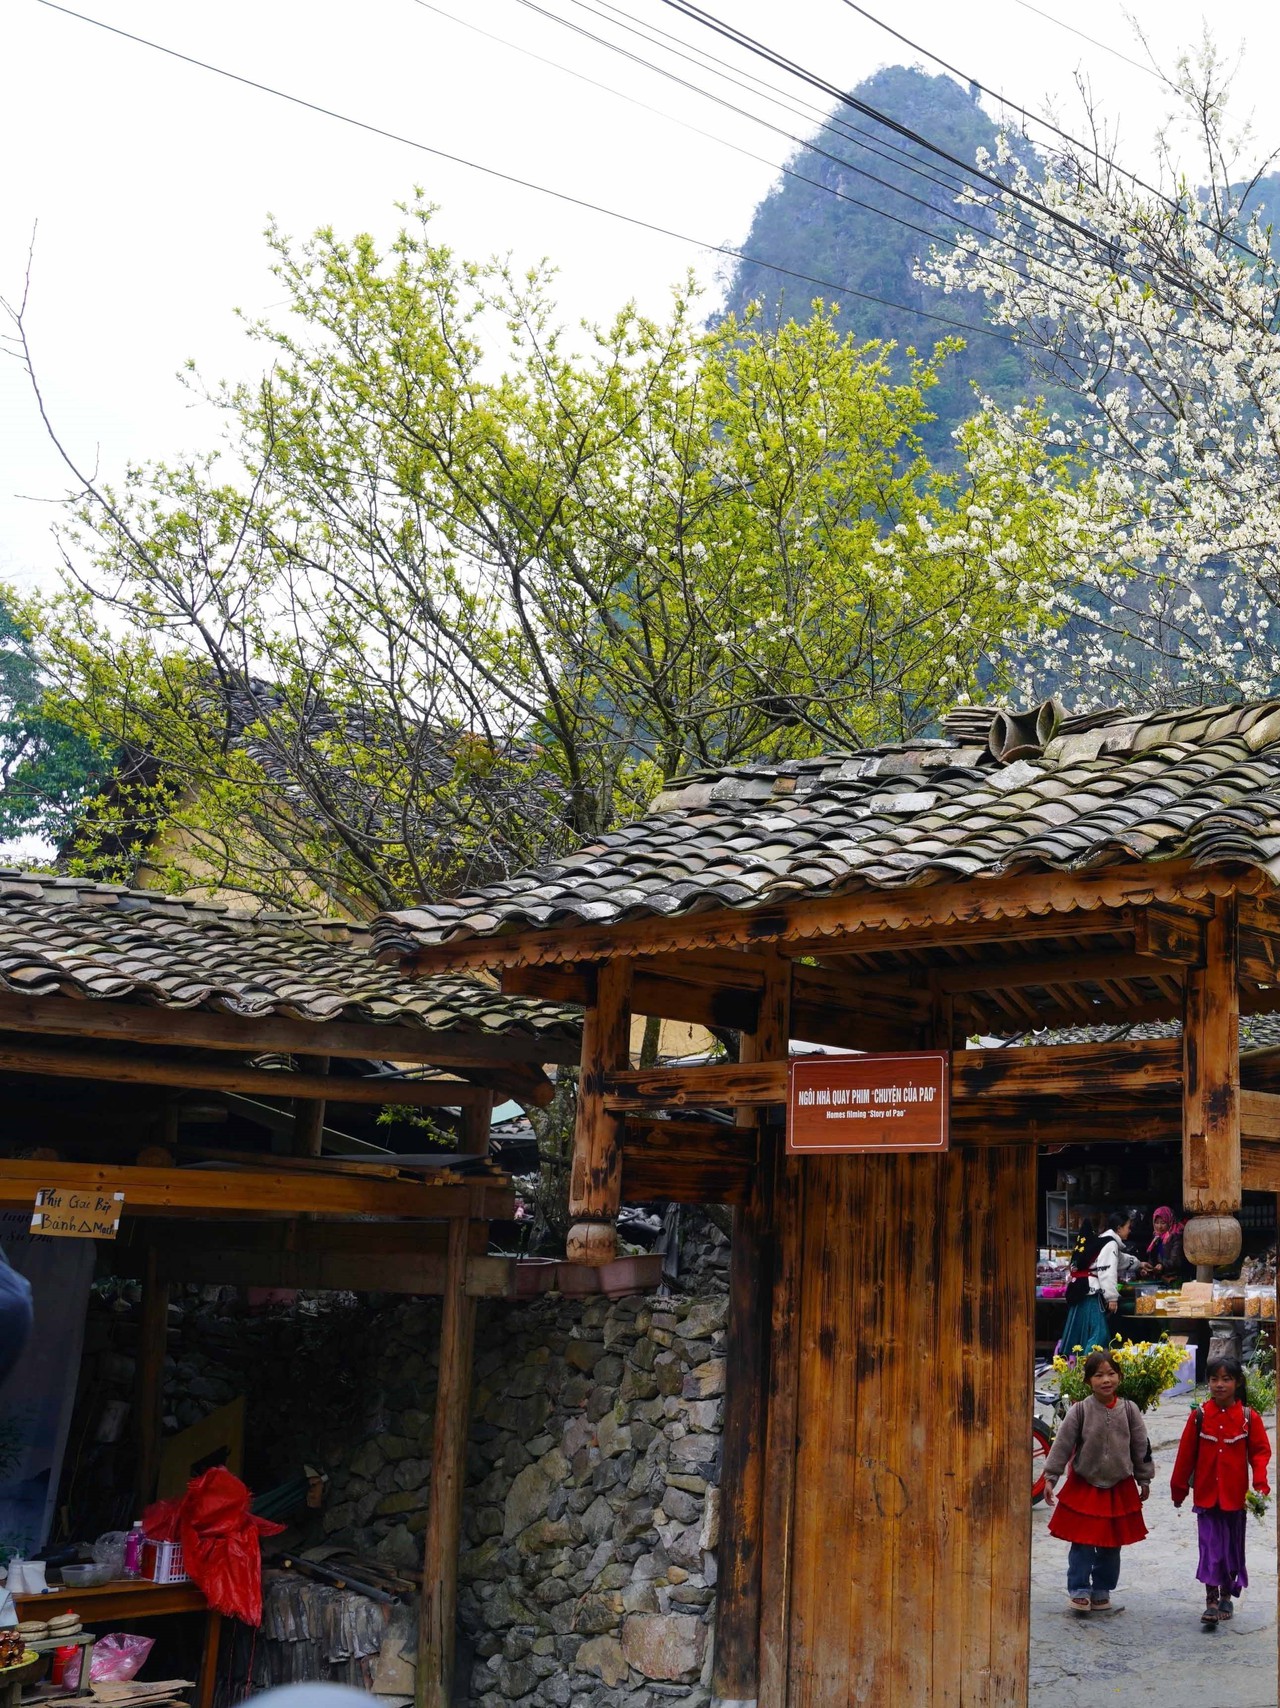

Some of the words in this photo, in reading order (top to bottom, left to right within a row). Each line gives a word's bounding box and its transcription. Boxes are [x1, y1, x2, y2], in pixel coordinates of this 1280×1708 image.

[798, 1087, 815, 1106] NGÔI
[816, 1087, 831, 1105] NHÀ
[832, 1090, 850, 1107] QUAY
[851, 1089, 870, 1104] PHIM
[903, 1081, 918, 1102] CỦA
[826, 1110, 846, 1119] Homes
[846, 1109, 867, 1119] filming
[886, 1109, 892, 1118] of
[41, 1213, 76, 1229] Bánh
